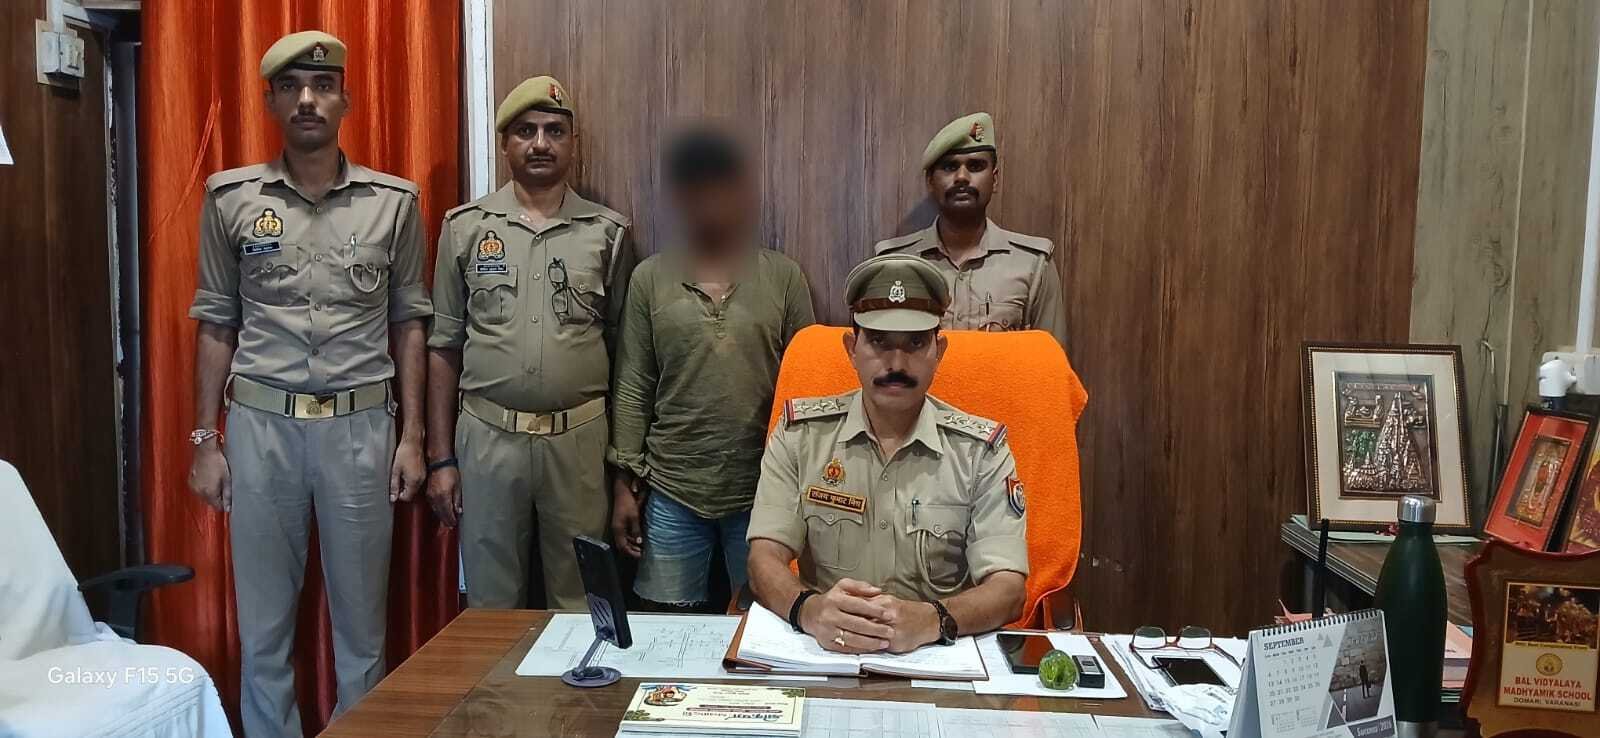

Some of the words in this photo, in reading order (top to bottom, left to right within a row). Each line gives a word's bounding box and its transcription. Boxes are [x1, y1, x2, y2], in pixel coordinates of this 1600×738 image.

[1264, 637, 1304, 651] SEPTEMBER
[1515, 676, 1531, 685] BAL
[1534, 677, 1581, 688] VIDYALAYA
[1504, 687, 1555, 698] MADHYAMIK
[1558, 691, 1592, 700] SCHOOL
